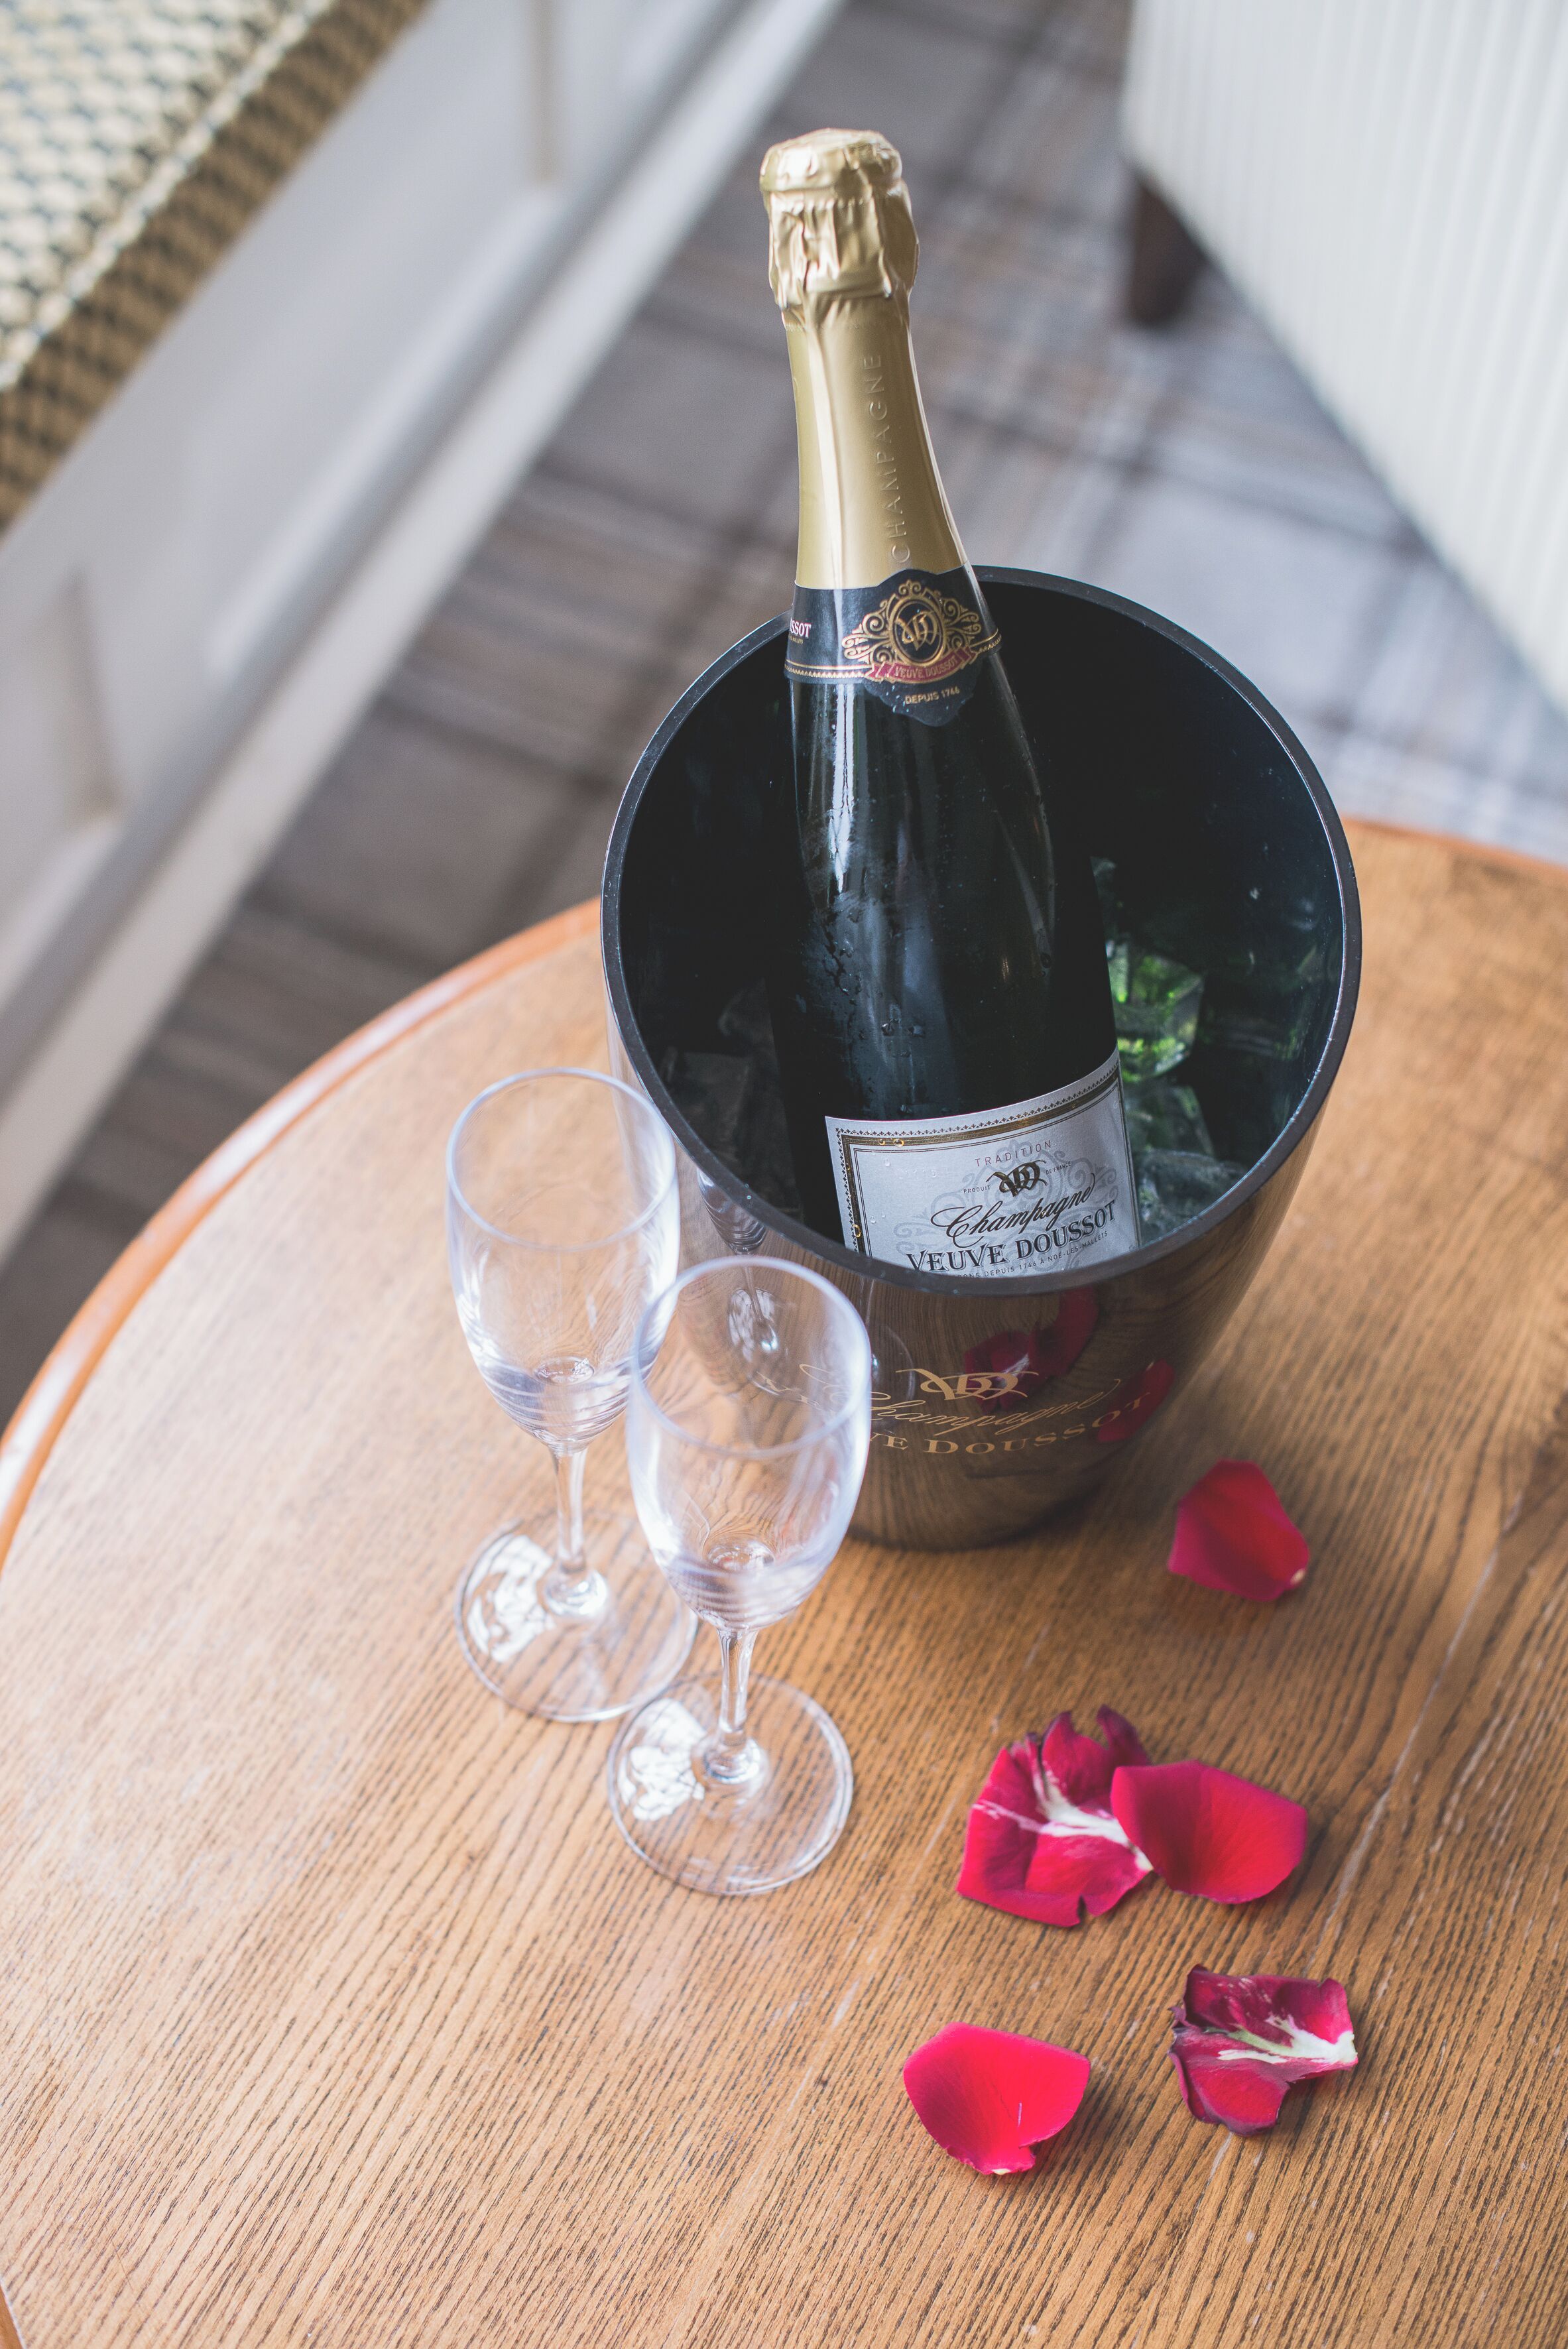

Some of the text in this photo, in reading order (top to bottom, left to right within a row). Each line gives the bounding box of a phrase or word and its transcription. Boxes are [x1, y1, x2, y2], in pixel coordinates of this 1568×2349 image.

[863, 354, 911, 564] CHAMPAGNE
[895, 654, 958, 679] VEUVE DOUSSOT
[905, 691, 939, 705] DEPUIS
[975, 1140, 1052, 1167] TRADITION
[963, 1185, 991, 1194] PRODUIT
[1053, 1161, 1072, 1172] FRANCE
[930, 1173, 1096, 1248] Champagne
[906, 1199, 1116, 1272] VEUVE DOUSSOT
[984, 1266, 1015, 1277] DEPUIS
[923, 1391, 1151, 1454] DOUSSOT
